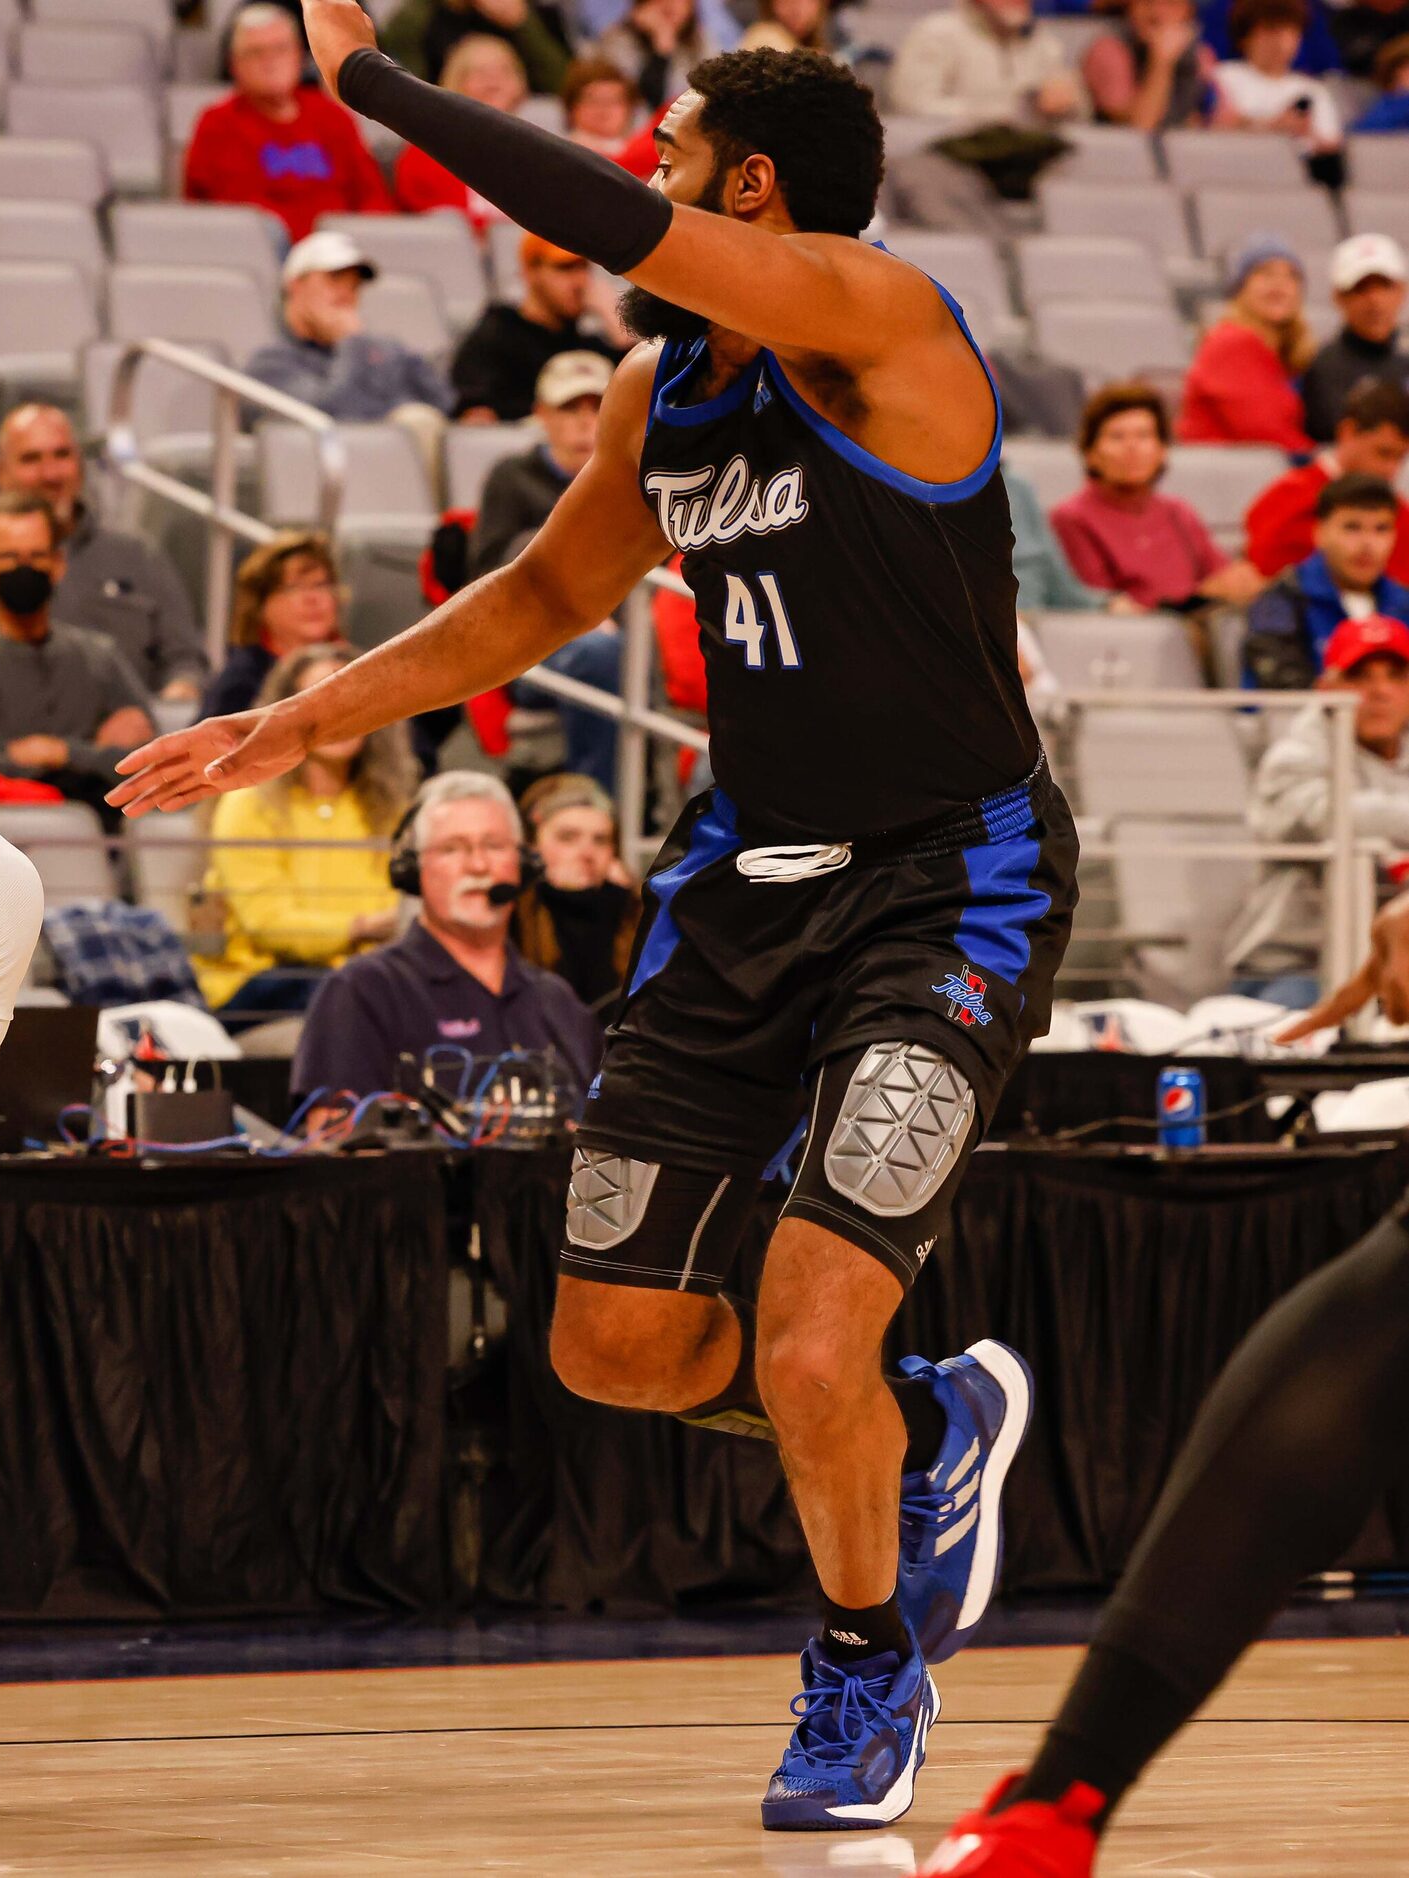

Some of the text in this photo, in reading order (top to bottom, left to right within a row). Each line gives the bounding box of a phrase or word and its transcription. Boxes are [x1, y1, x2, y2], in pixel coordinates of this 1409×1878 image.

[645, 453, 809, 552] Tulsa
[725, 571, 803, 669] 41
[931, 973, 993, 1026] Tulsa
